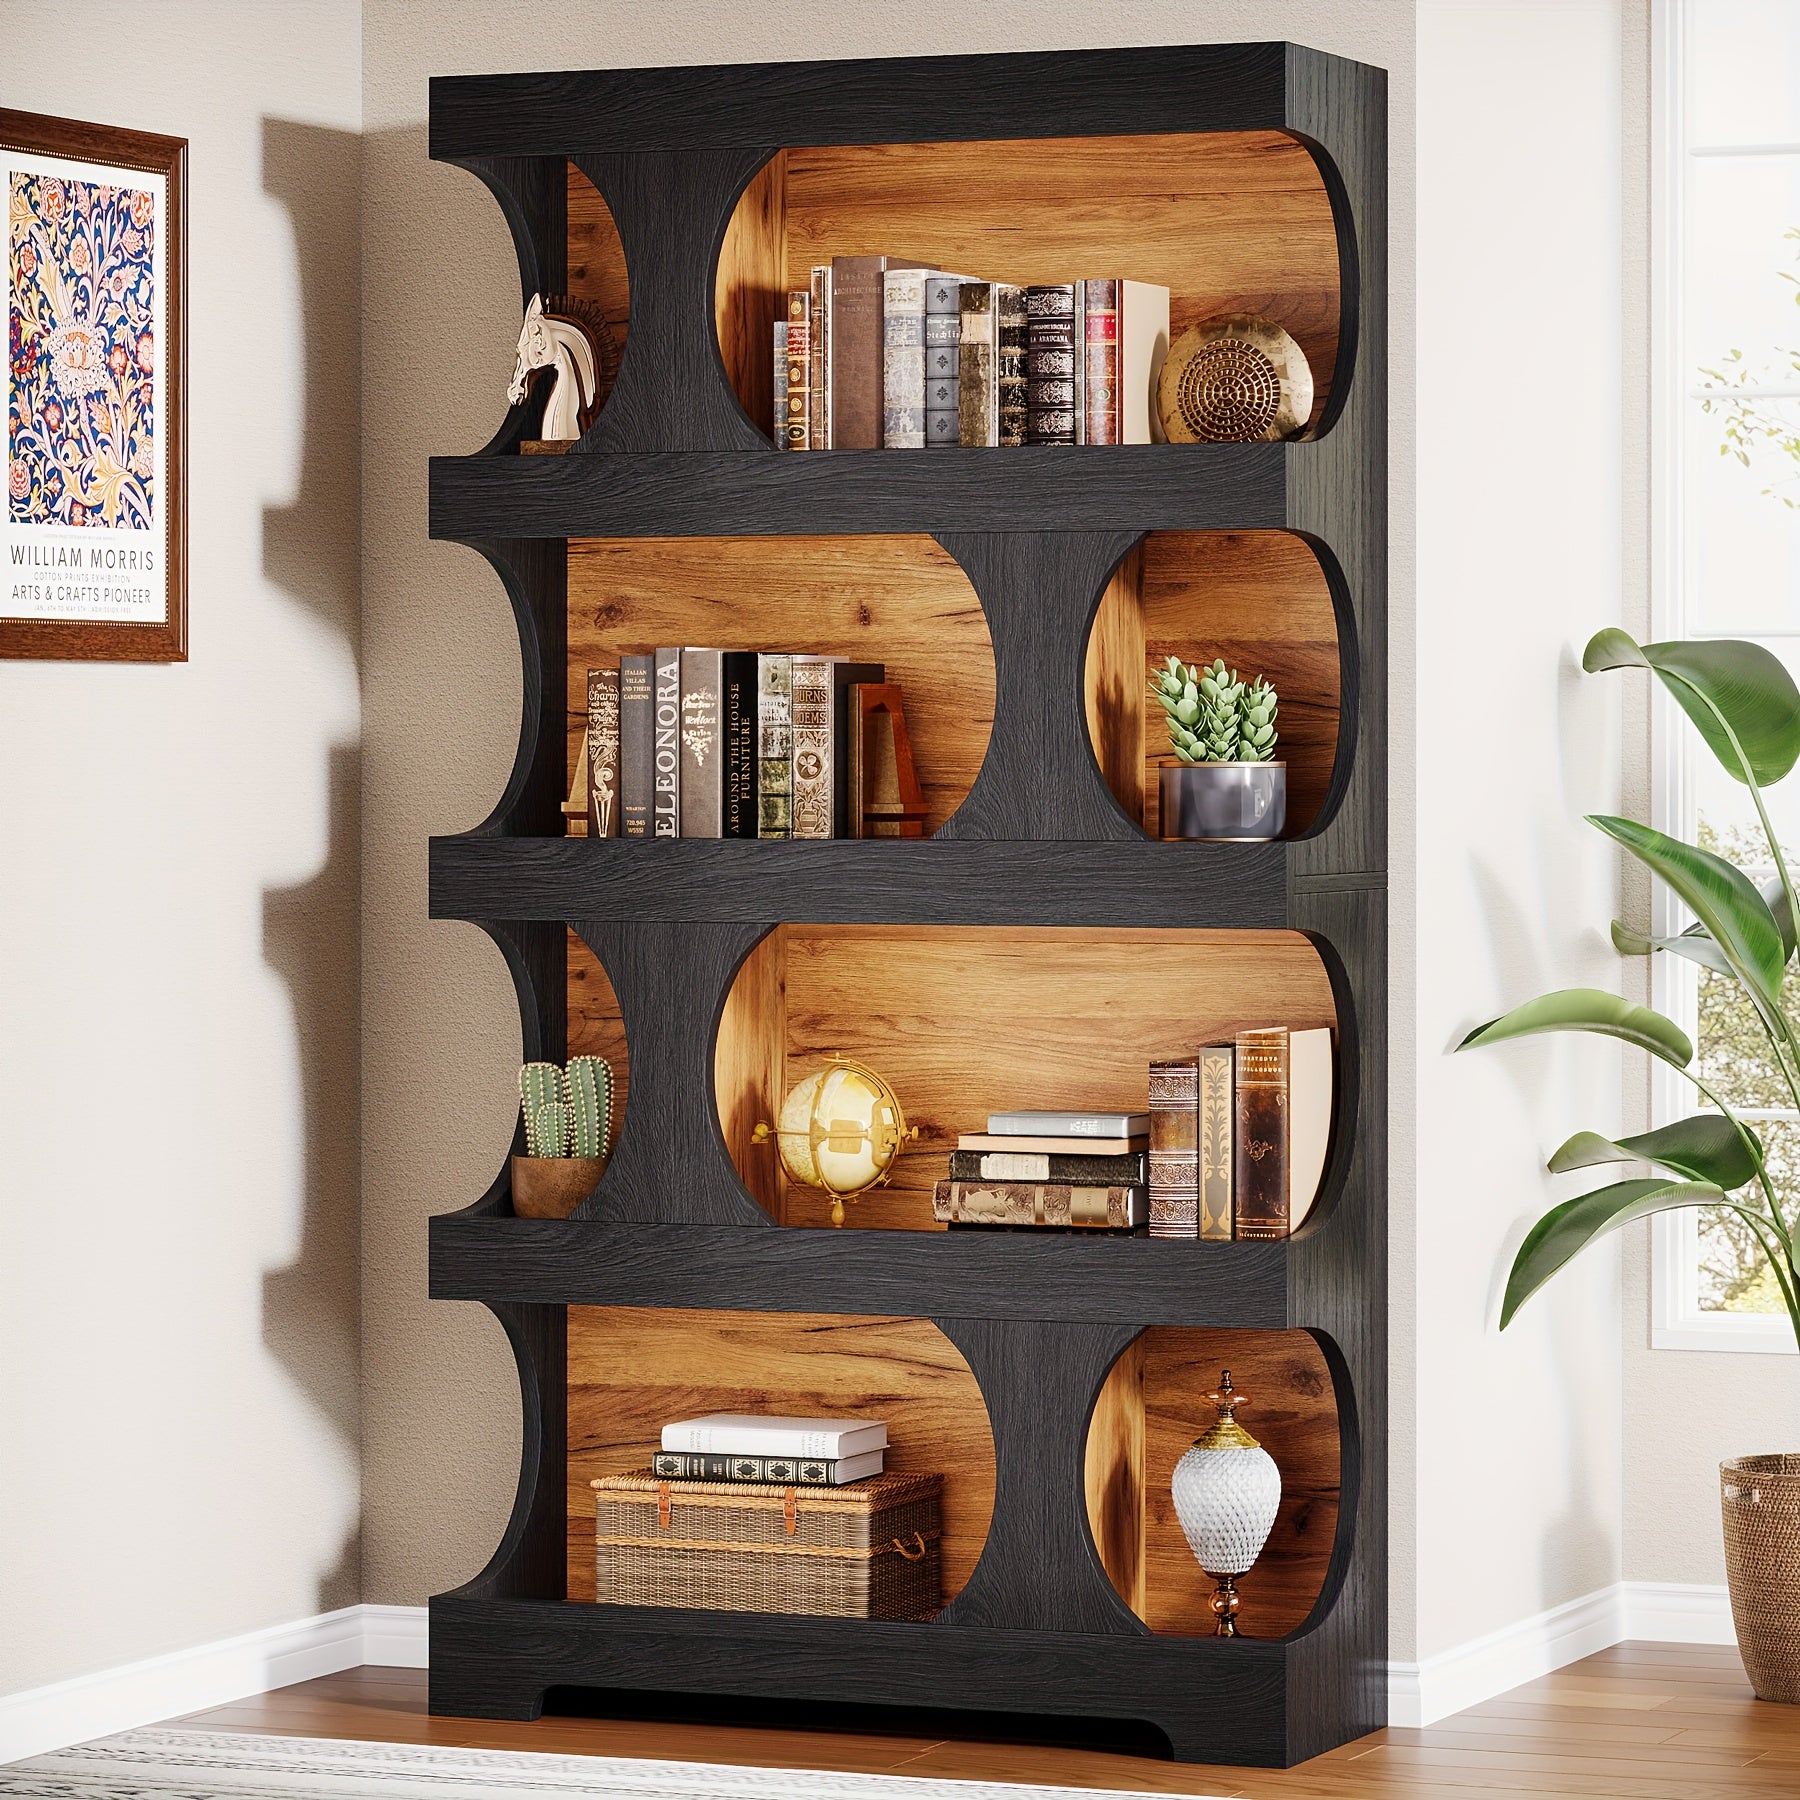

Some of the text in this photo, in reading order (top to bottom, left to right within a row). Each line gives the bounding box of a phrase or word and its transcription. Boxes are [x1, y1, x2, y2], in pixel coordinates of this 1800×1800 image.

[1039, 335, 1069, 343] ARAUCANA
[10, 544, 154, 571] WILLIAM MORRIS
[33, 571, 131, 584] COTTON PRINTS EXHIBITION
[12, 584, 151, 604] ARTS & CRAFTS PIONEER
[588, 690, 618, 701] Charm
[795, 690, 828, 703] BURNS
[655, 661, 679, 838] ELEONORA
[730, 683, 739, 833] AROUND THE HOUSE
[741, 717, 750, 799] FURNITURE
